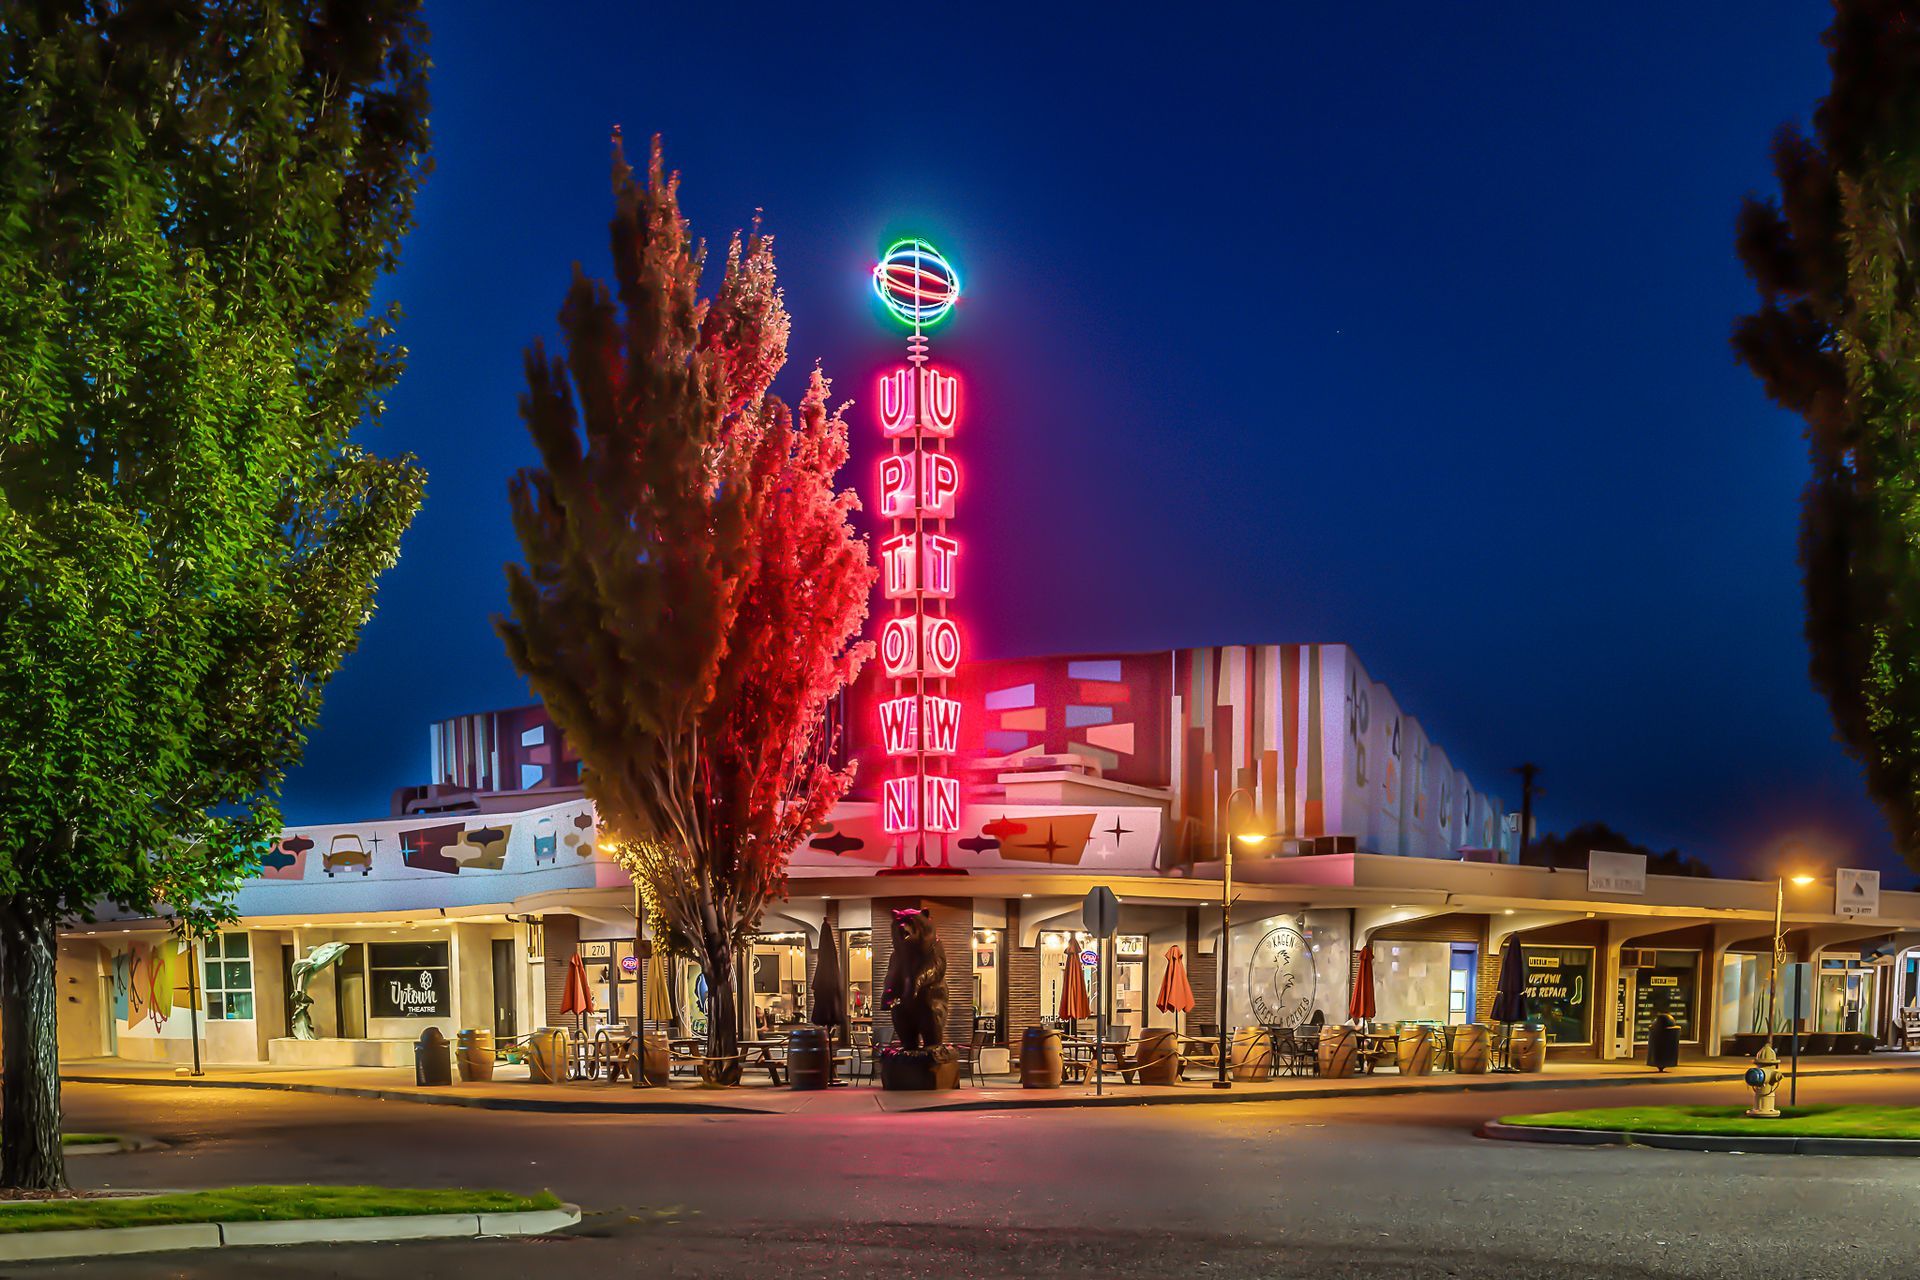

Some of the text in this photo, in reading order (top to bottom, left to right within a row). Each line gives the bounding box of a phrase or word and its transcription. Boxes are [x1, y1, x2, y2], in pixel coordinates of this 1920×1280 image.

[879, 369, 910, 831] UPTOWN
[930, 368, 961, 831] UPTOWN
[592, 945, 606, 956] 270
[1121, 940, 1136, 952] 270
[1529, 974, 1561, 984] UPTOWN
[391, 981, 438, 1011] Uptown
[1539, 987, 1567, 998] REPAIR
